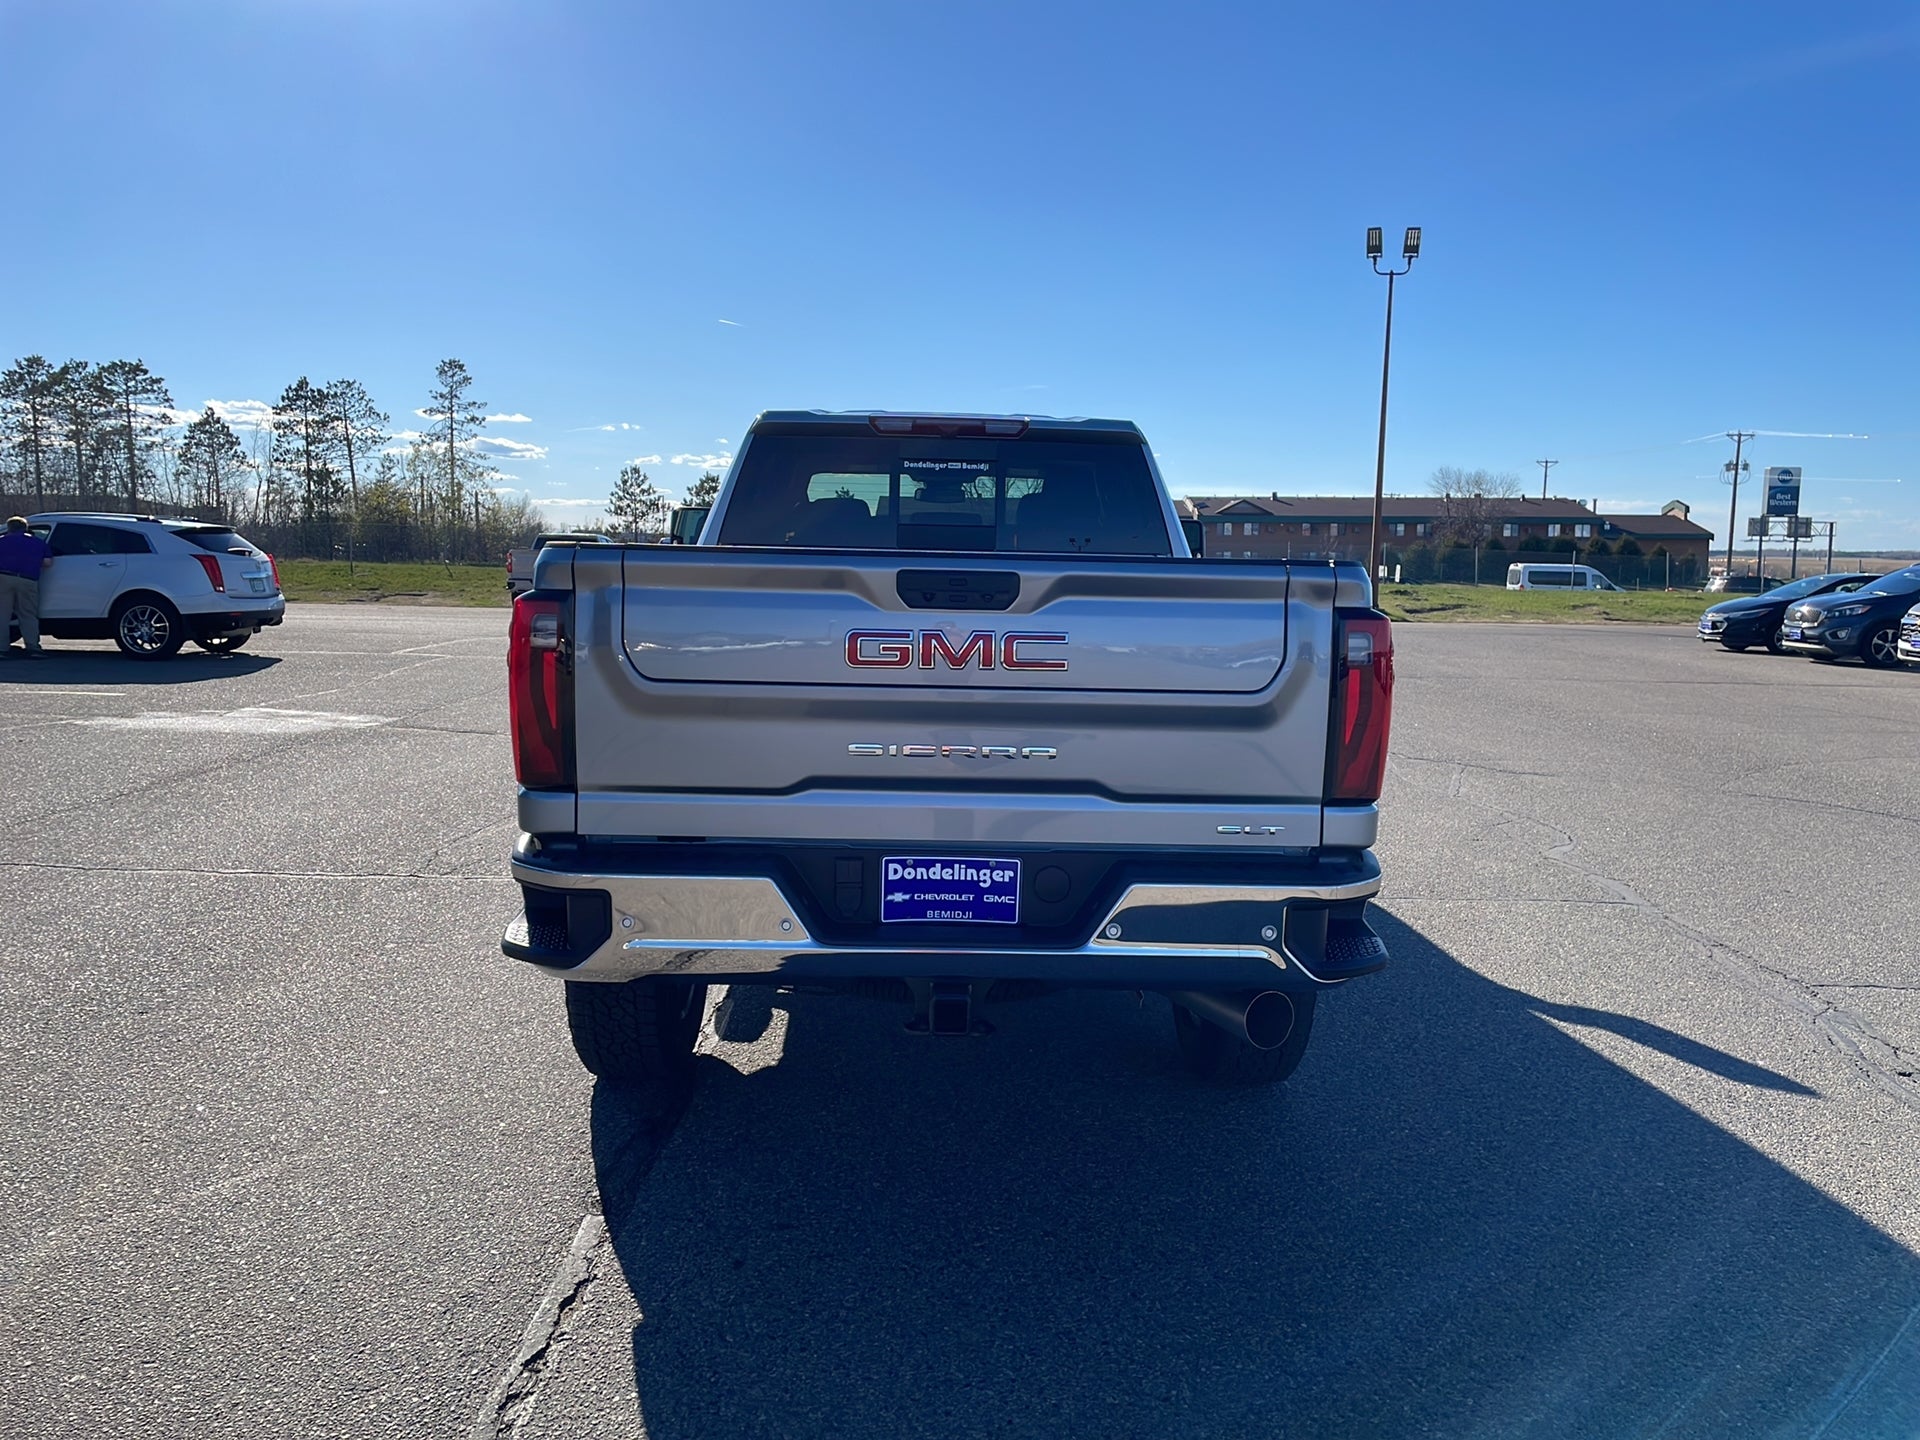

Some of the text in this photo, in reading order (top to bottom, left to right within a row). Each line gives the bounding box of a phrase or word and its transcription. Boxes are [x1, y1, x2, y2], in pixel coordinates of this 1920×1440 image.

[904, 461, 947, 470] Dondelinger
[962, 462, 989, 471] Bemidji
[845, 628, 1069, 671] GMC
[848, 743, 1057, 760] SIERRA
[1216, 825, 1286, 835] SLT
[888, 863, 1014, 887] Dondelinger
[914, 893, 1015, 904] CHEVROLET GMC
[926, 910, 973, 919] BEMIDJI
